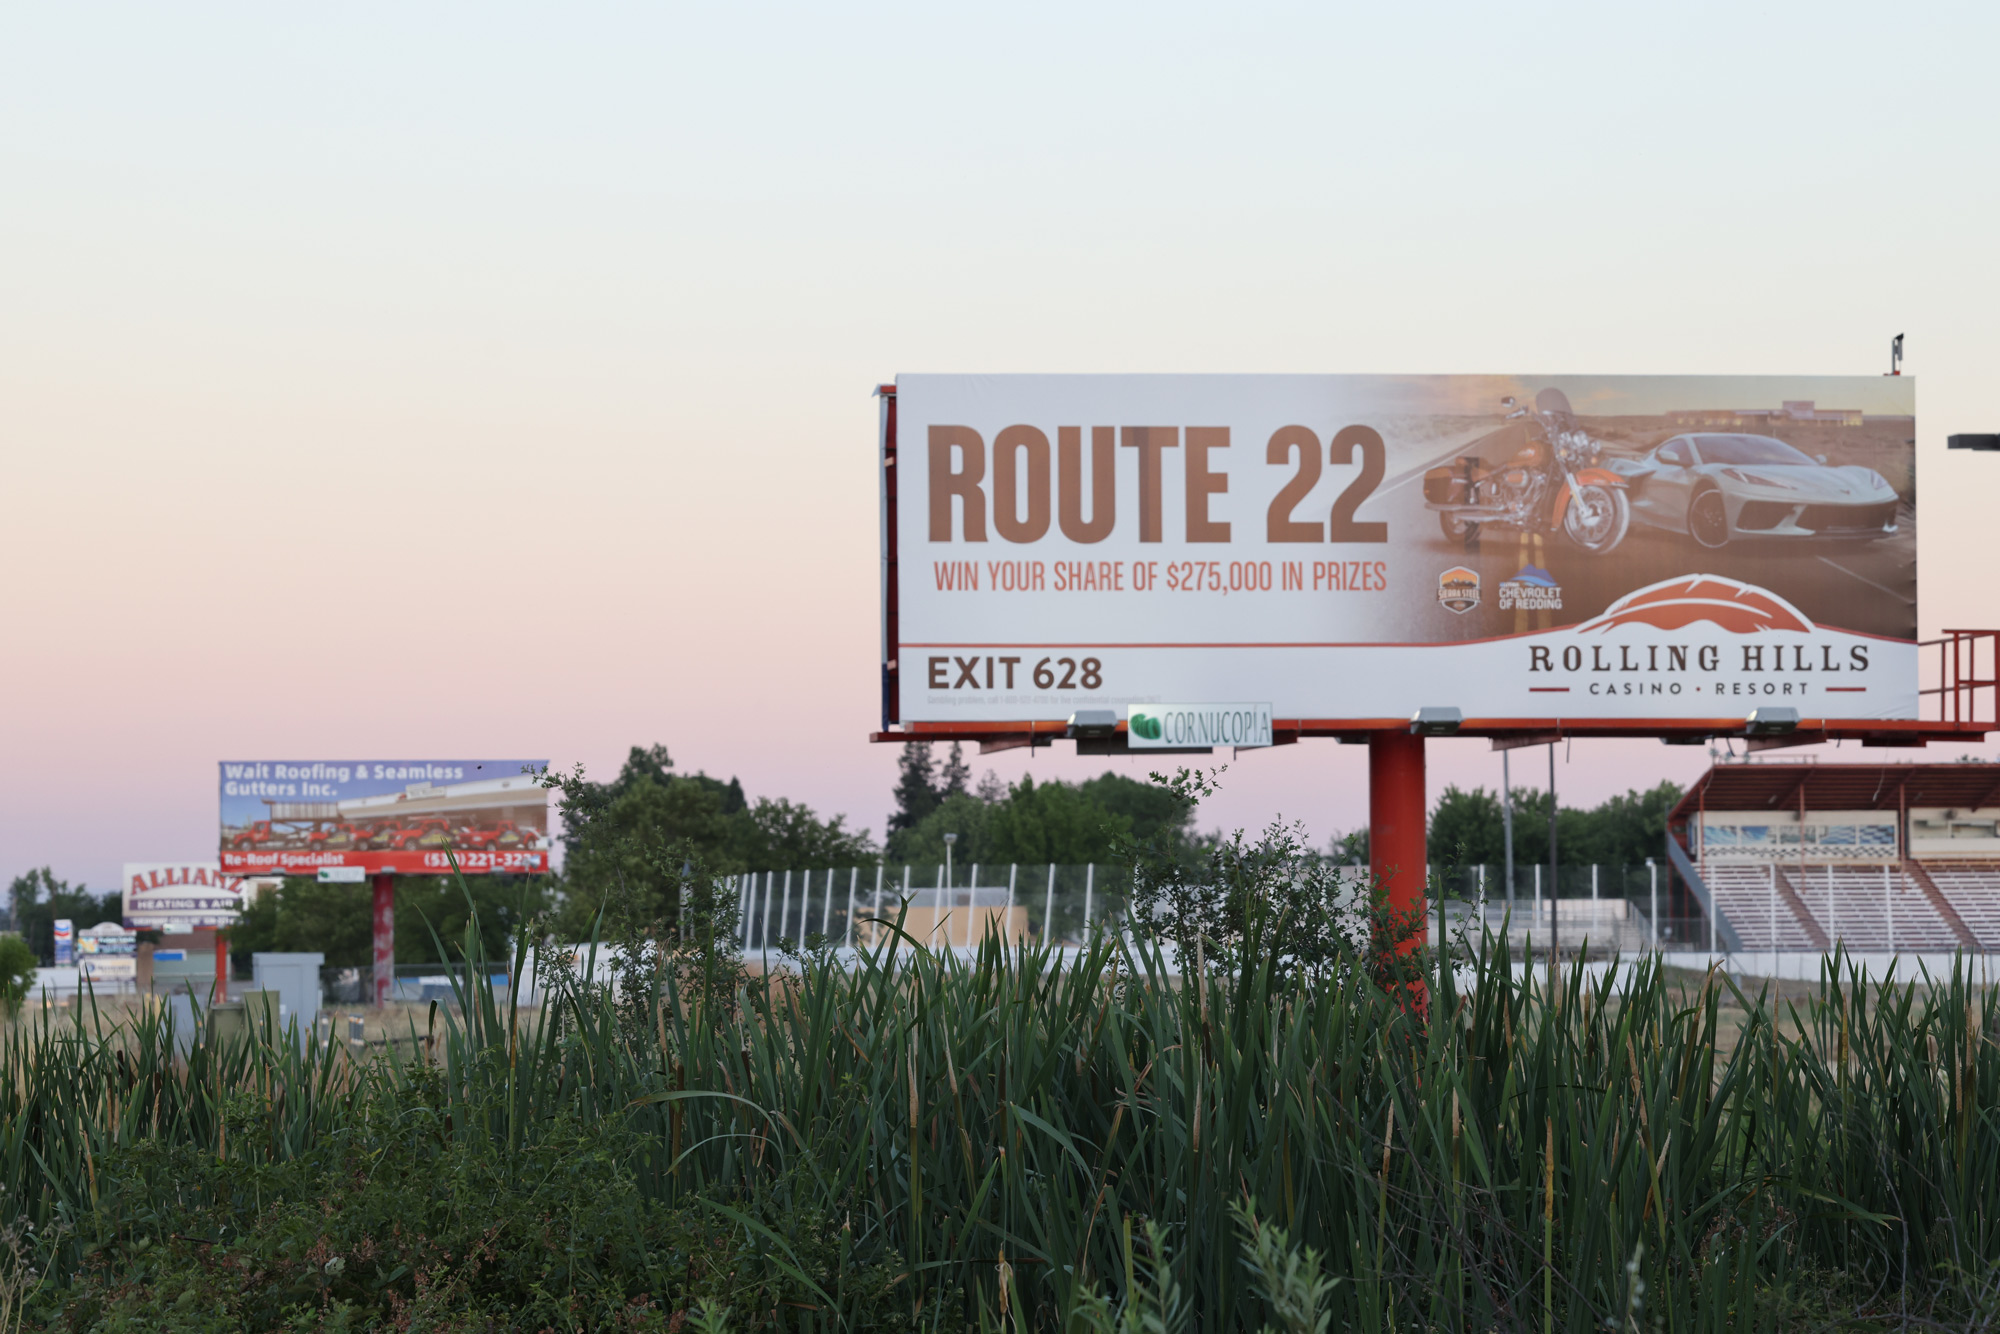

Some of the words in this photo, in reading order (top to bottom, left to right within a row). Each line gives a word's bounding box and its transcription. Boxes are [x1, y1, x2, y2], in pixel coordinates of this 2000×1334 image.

[927, 424, 1232, 543] ROUTE
[1266, 424, 1388, 543] 22
[933, 560, 978, 592] WIN
[987, 560, 1045, 592] YOUR
[1053, 560, 1124, 592] SHARE
[1132, 560, 1158, 592] OF
[1166, 560, 1272, 596] $275,000
[1281, 561, 1303, 592] IN
[1312, 560, 1387, 592] PRIZES
[1499, 587, 1562, 599] CHEVROLET
[1499, 599, 1513, 610] OF
[1515, 599, 1562, 610] REDDING
[1528, 645, 1720, 672] ROLLING
[1741, 645, 1869, 672] HILLS
[928, 656, 1021, 690] EXIT
[1032, 656, 1103, 690] 628
[1589, 682, 1682, 695] CASINO
[1715, 682, 1808, 695] RESORT
[1164, 711, 1271, 743] CORNUCOPIA
[225, 763, 269, 779] Wait
[275, 764, 350, 783] Roofing
[355, 765, 368, 779] &
[374, 763, 463, 779] Seamless
[225, 781, 296, 796] Gutters
[302, 782, 338, 796] Inc.
[224, 853, 278, 866] Re-Roof
[280, 853, 344, 867] Specialist
[131, 867, 243, 895] ALLIANZ
[137, 900, 195, 909] HEATING
[198, 900, 208, 908] &
